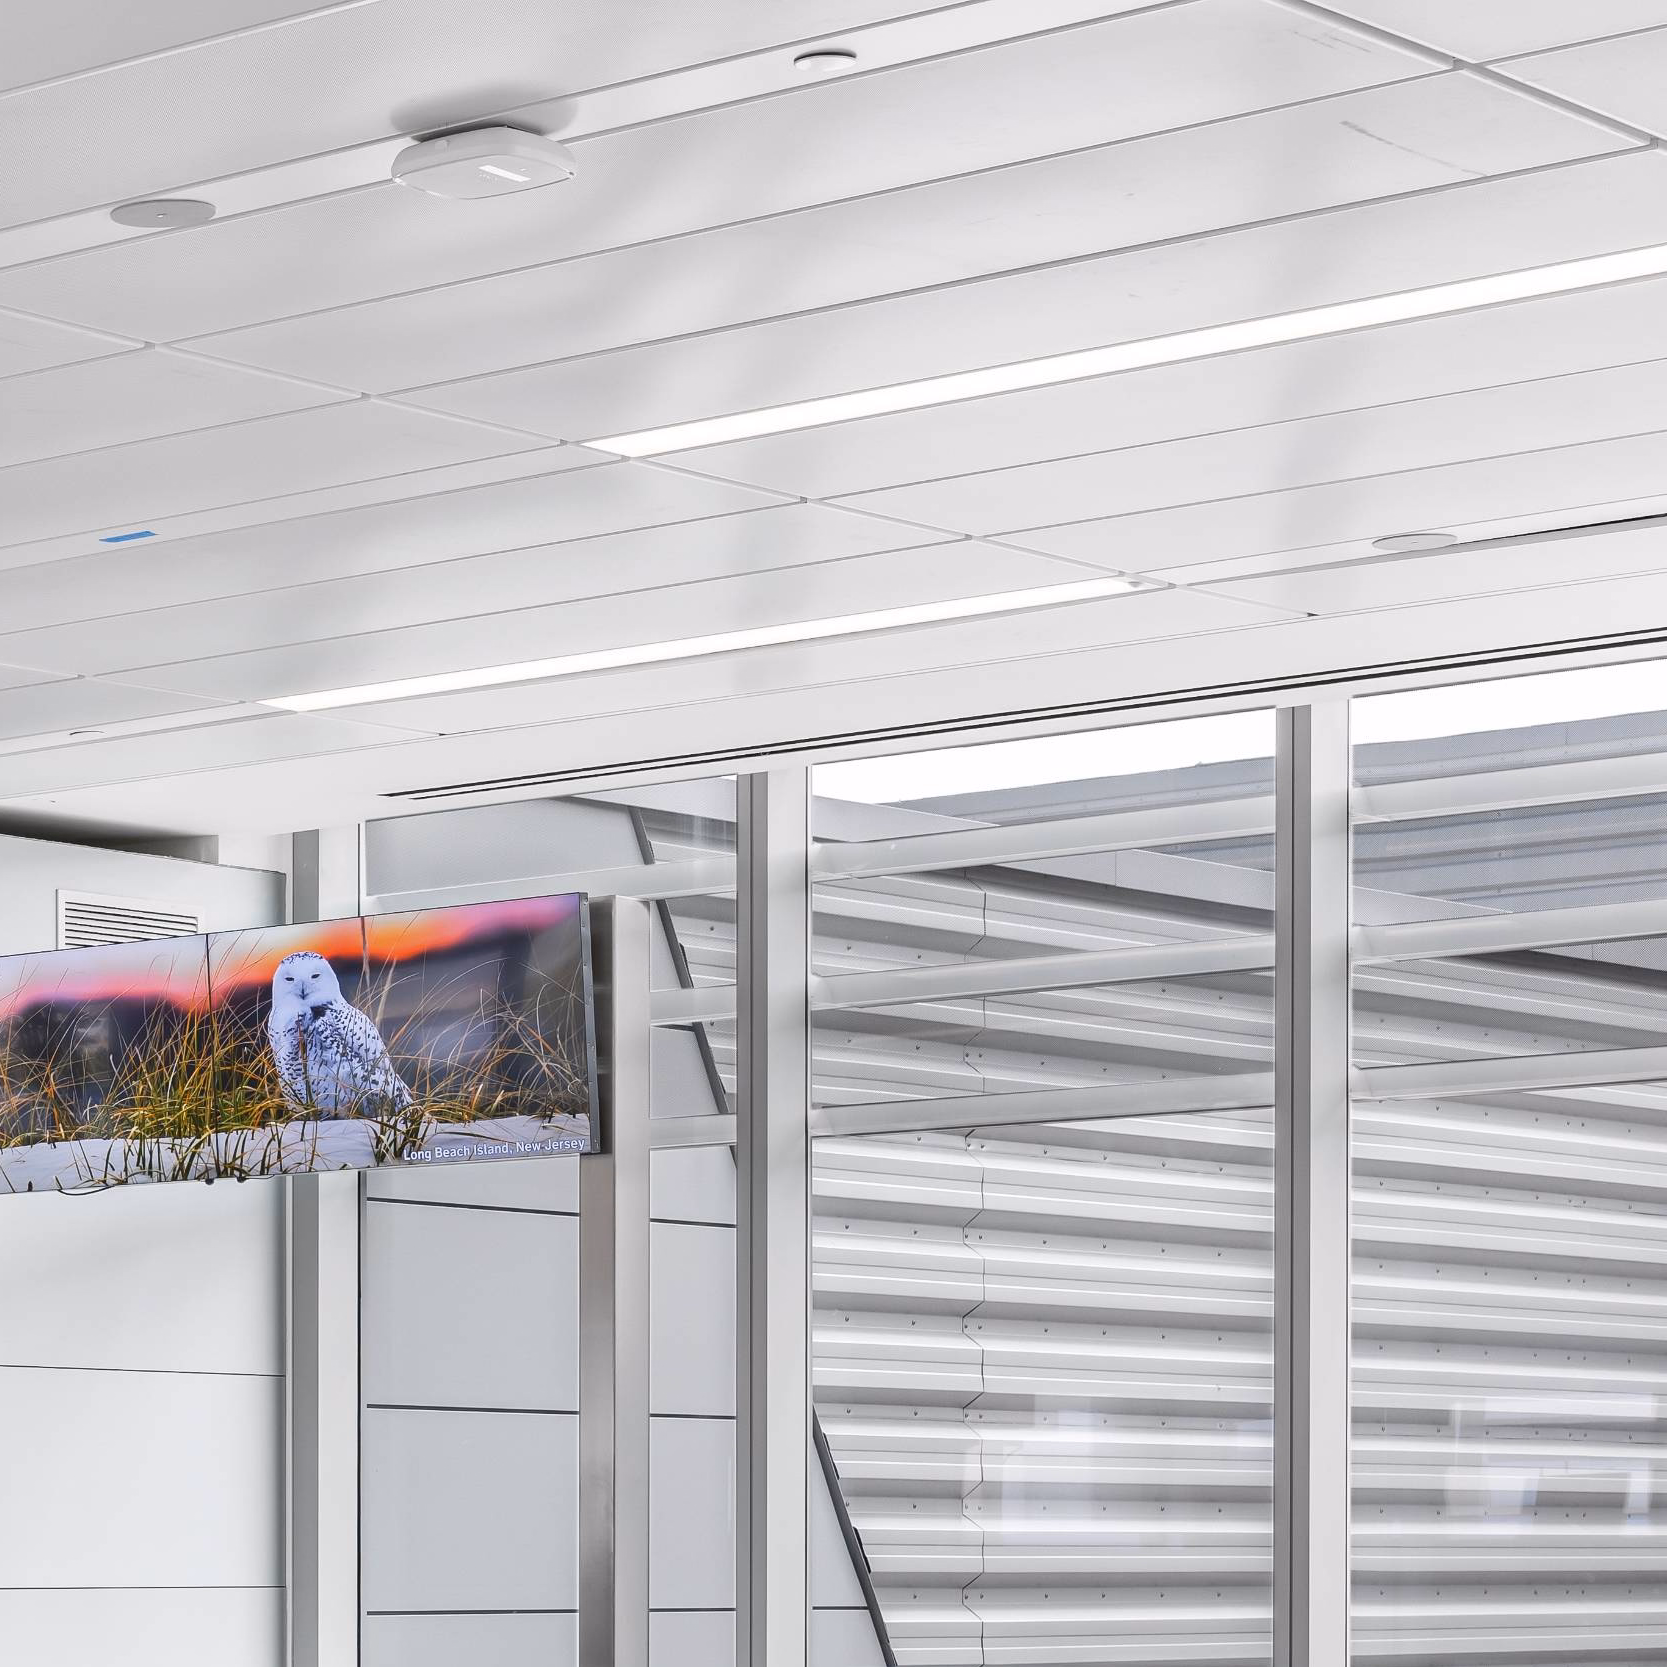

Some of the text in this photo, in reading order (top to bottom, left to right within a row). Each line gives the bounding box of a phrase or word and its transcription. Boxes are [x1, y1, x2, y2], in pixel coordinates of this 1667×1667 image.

[403, 1138, 585, 1162] Long Beach Island, New Jersey
